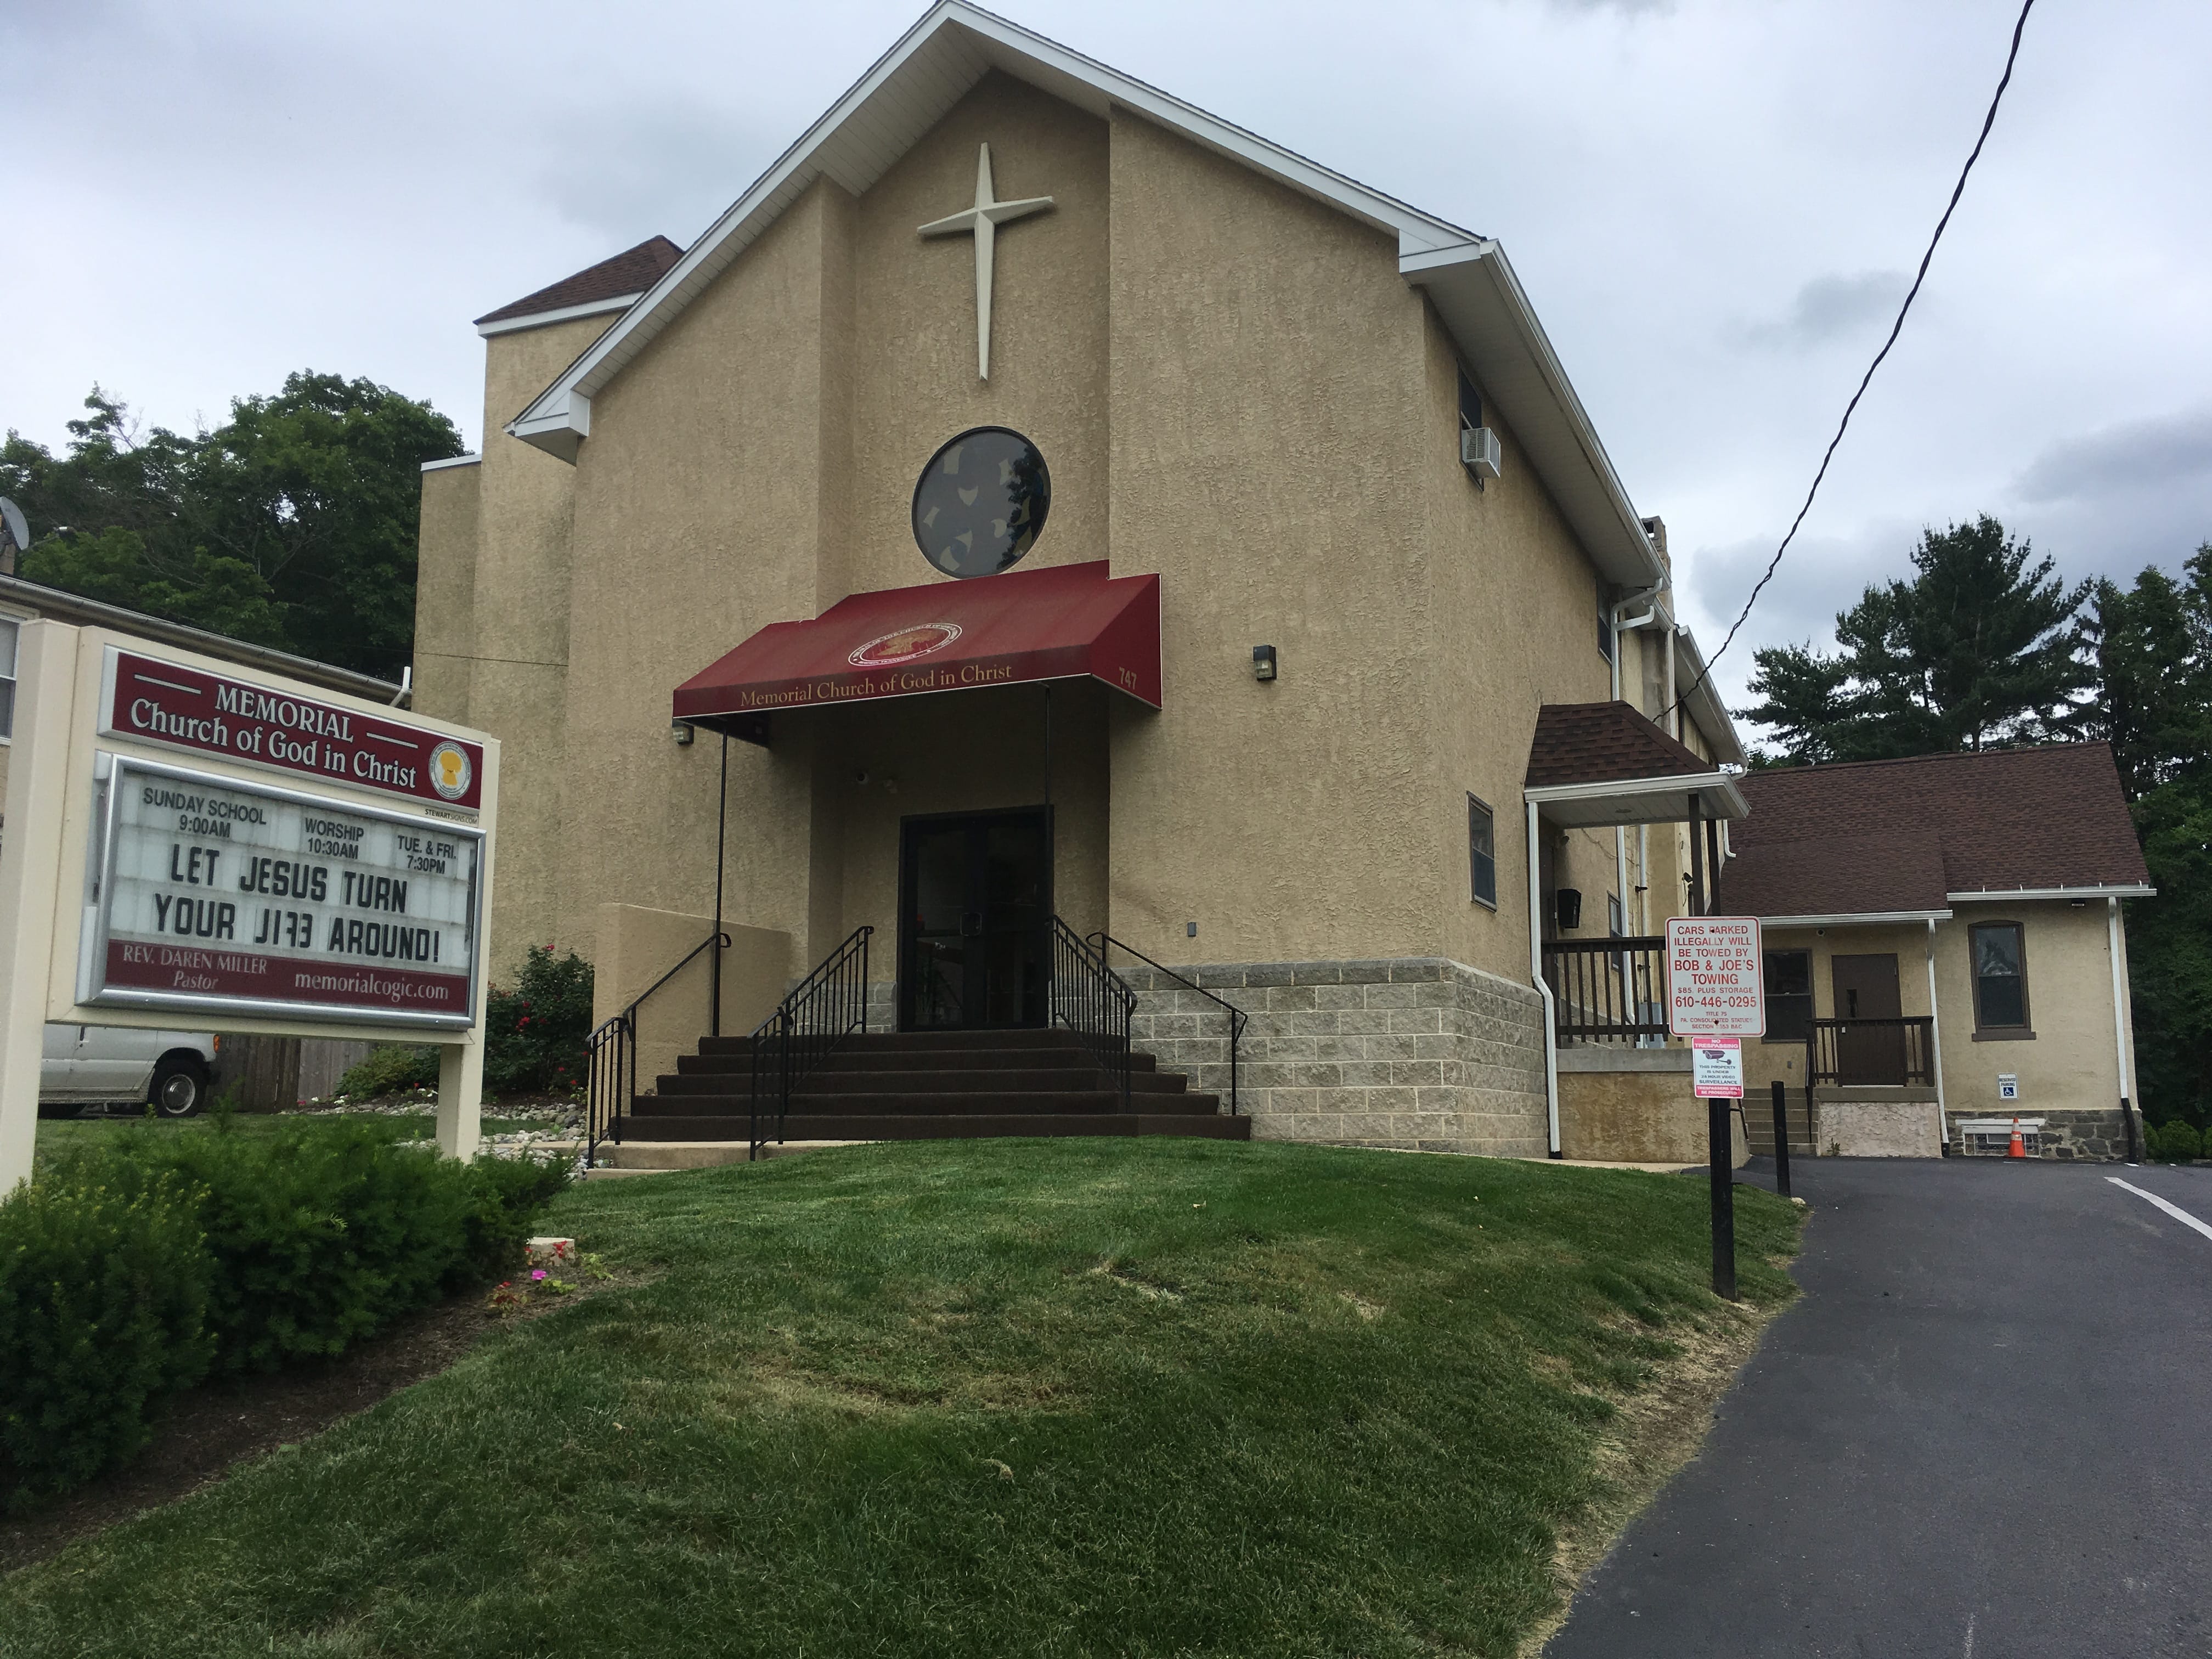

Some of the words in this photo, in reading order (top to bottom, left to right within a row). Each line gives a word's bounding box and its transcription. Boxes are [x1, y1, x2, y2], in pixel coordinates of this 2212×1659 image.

[741, 684, 812, 707] Memorial
[817, 678, 875, 699] Church
[880, 673, 898, 692] of
[901, 670, 935, 690] God
[940, 670, 956, 685] in
[961, 664, 1012, 682] Christ
[1119, 666, 1137, 690] 747
[215, 684, 354, 743] MEMORIAL
[131, 698, 228, 747] Church
[236, 725, 263, 754] of
[268, 730, 317, 767] God
[324, 743, 346, 772] in
[353, 750, 417, 789] Christ
[143, 787, 205, 814] SUNDAY
[208, 799, 267, 825] SCHOOL
[425, 809, 477, 825] STEWARTSIGNS.COM
[179, 815, 231, 838] 9:00AM
[305, 817, 364, 842] WORSHIP
[308, 837, 359, 860] 10:30AM
[398, 835, 422, 854] TUE.
[426, 840, 433, 855] &
[437, 842, 456, 859] FRI.
[407, 855, 445, 874] 7:30PM
[171, 843, 220, 887] LET
[240, 856, 328, 902] JESUS
[343, 871, 408, 913] TURN
[155, 893, 236, 941] YOUR
[329, 917, 439, 963] AROUND!
[1677, 926, 1705, 934] CARS
[1709, 926, 1748, 934] PARKED
[1674, 938, 1724, 946] ILLEGALLY
[1729, 937, 1752, 945] WILL
[1678, 949, 1691, 957] BE
[1696, 949, 1731, 957] TOWED
[1735, 948, 1748, 957] BY
[123, 944, 154, 964] REV.
[160, 949, 213, 969] DAREN
[217, 955, 268, 974] MILLER
[1674, 960, 1700, 970] BOB
[1705, 960, 1713, 970] &
[1719, 960, 1754, 970] JOE'S
[173, 970, 219, 990] Pastor
[295, 972, 449, 1003] memorialcogic.com
[1691, 973, 1739, 985] TOWING
[1675, 996, 1757, 1007] 610-446-0295
